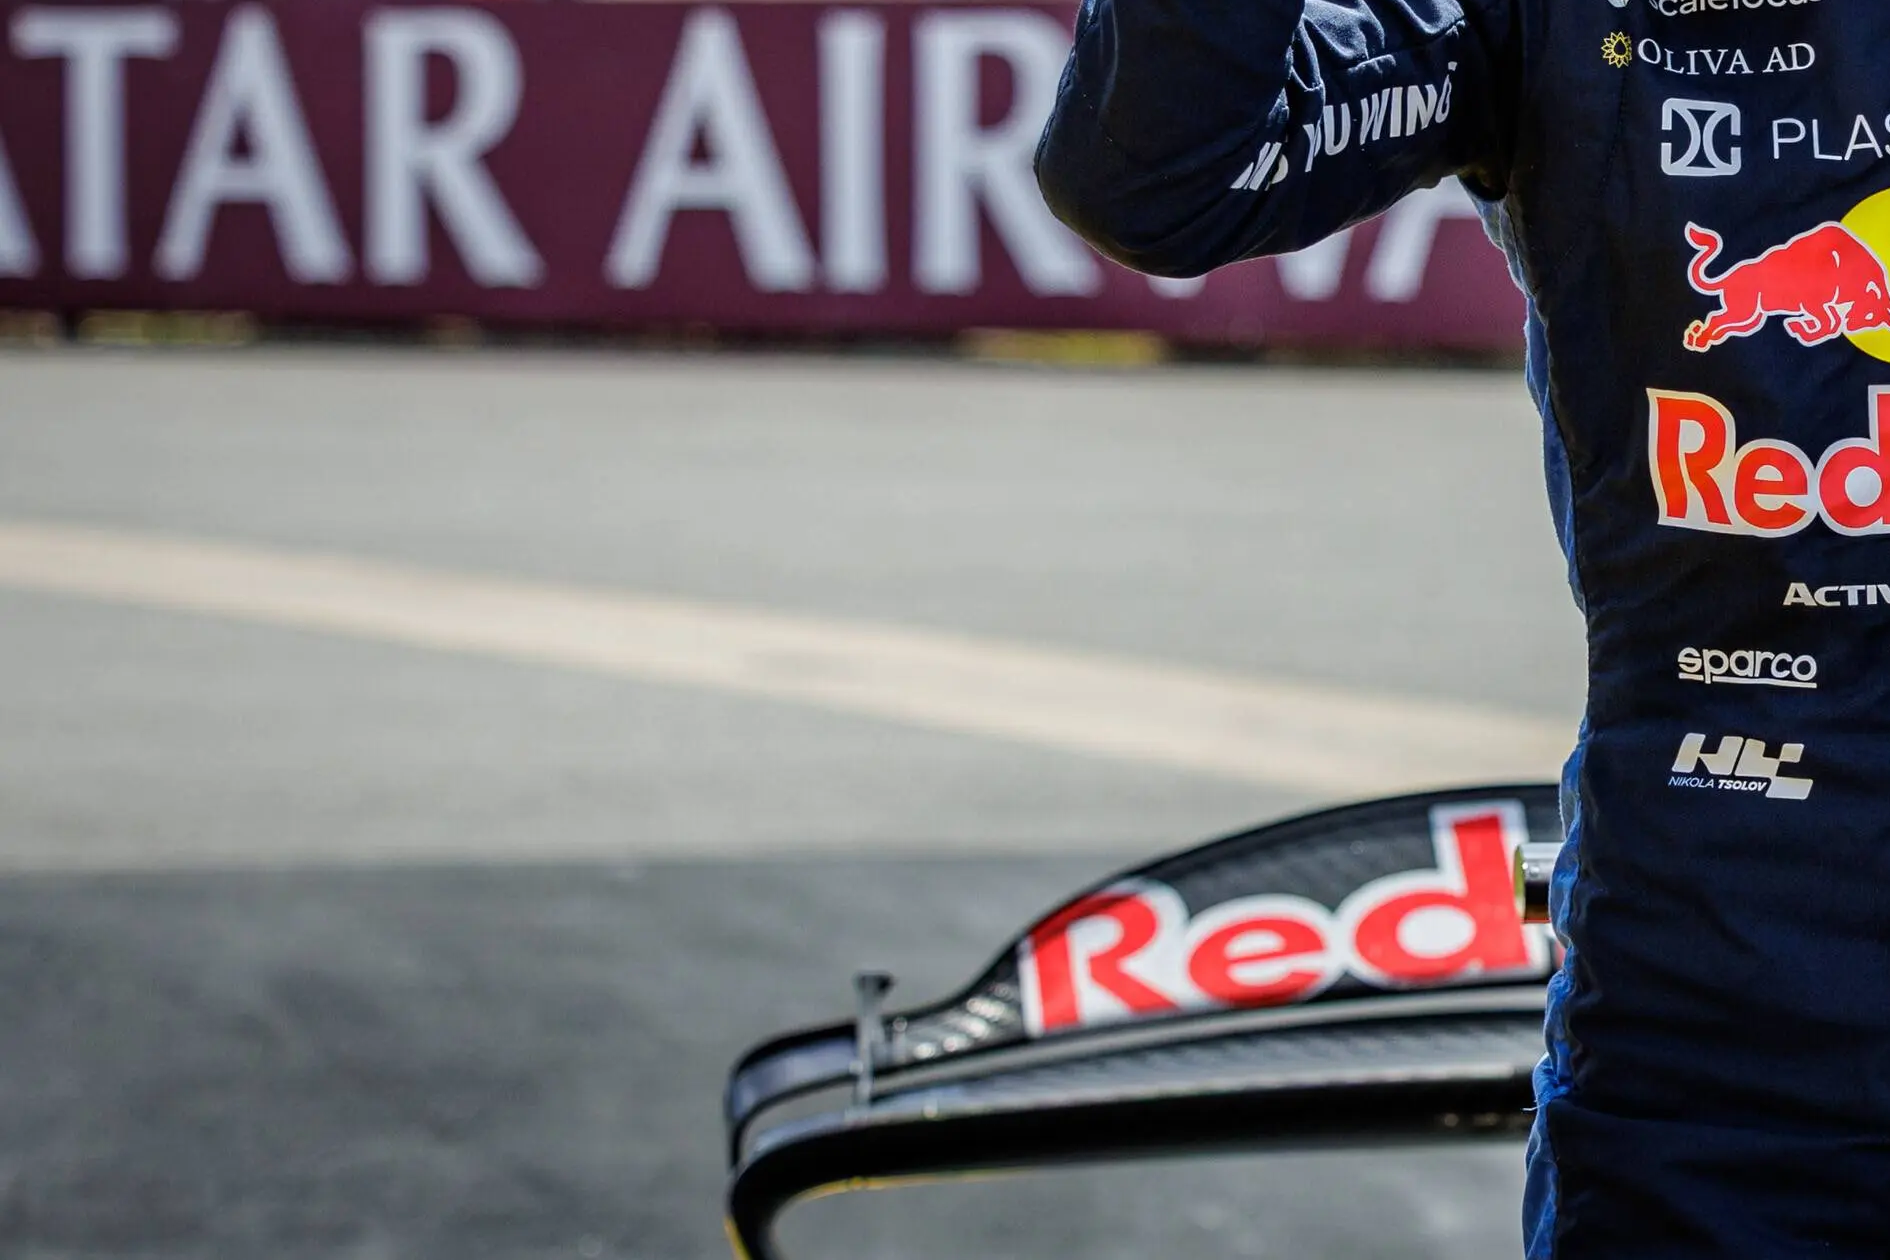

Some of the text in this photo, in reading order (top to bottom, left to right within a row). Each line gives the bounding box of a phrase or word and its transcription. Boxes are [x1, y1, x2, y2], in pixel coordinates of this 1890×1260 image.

[1638, 38, 1816, 75] OLIVA AD
[1360, 61, 1457, 146] WING
[1677, 647, 1817, 685] sparco
[1668, 775, 1767, 792] NIKOLA TSOLOV
[1020, 800, 1543, 1035] Red
